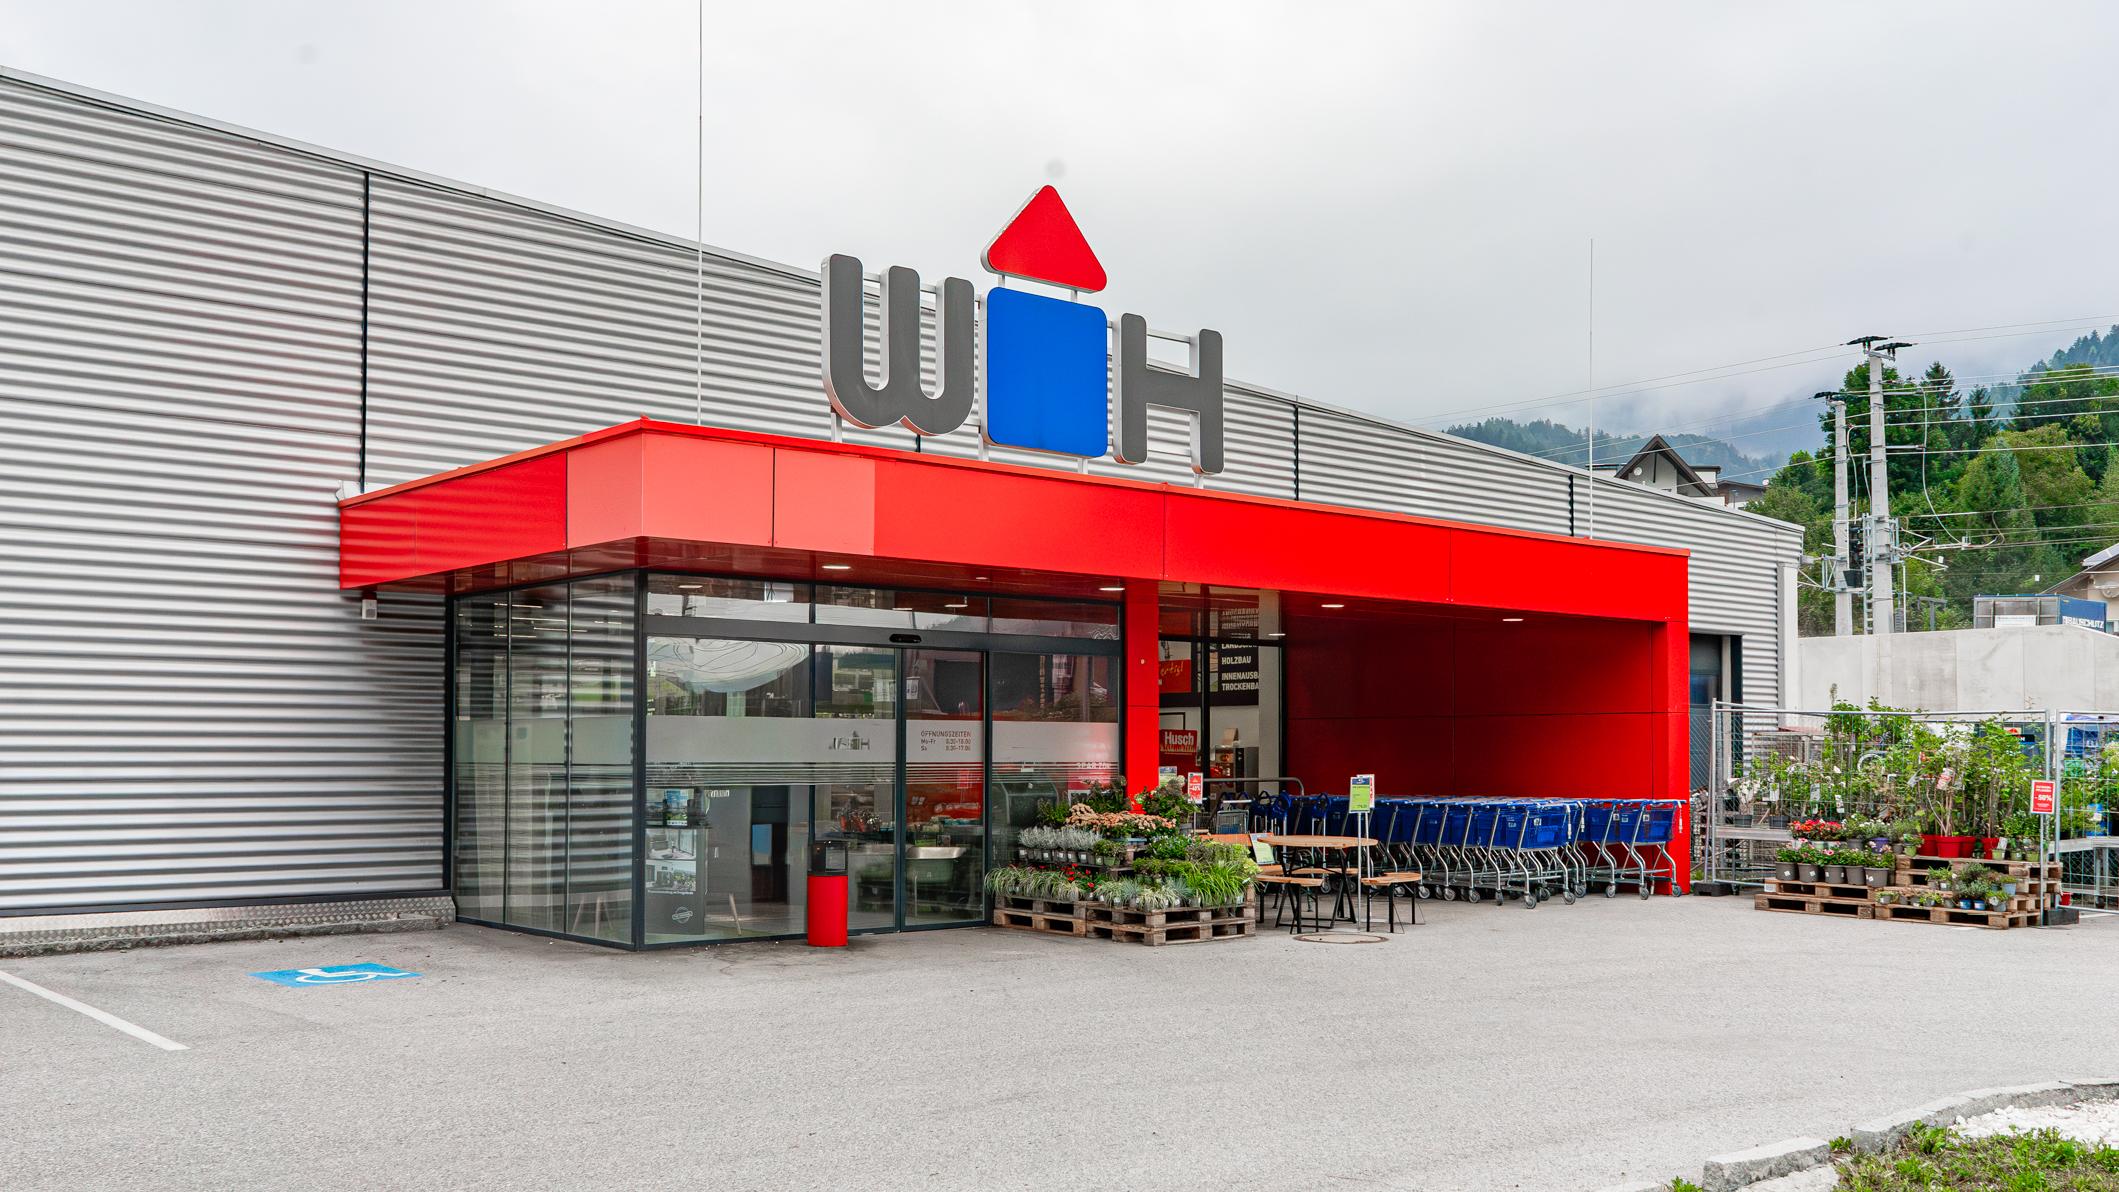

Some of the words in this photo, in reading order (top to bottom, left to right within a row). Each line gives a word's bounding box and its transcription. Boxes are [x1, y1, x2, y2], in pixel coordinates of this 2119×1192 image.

[1113, 312, 1224, 474] H
[1221, 655, 1252, 665] HOLZBAU
[1221, 671, 1259, 681] INNENAUSB
[1164, 731, 1195, 746] Husch
